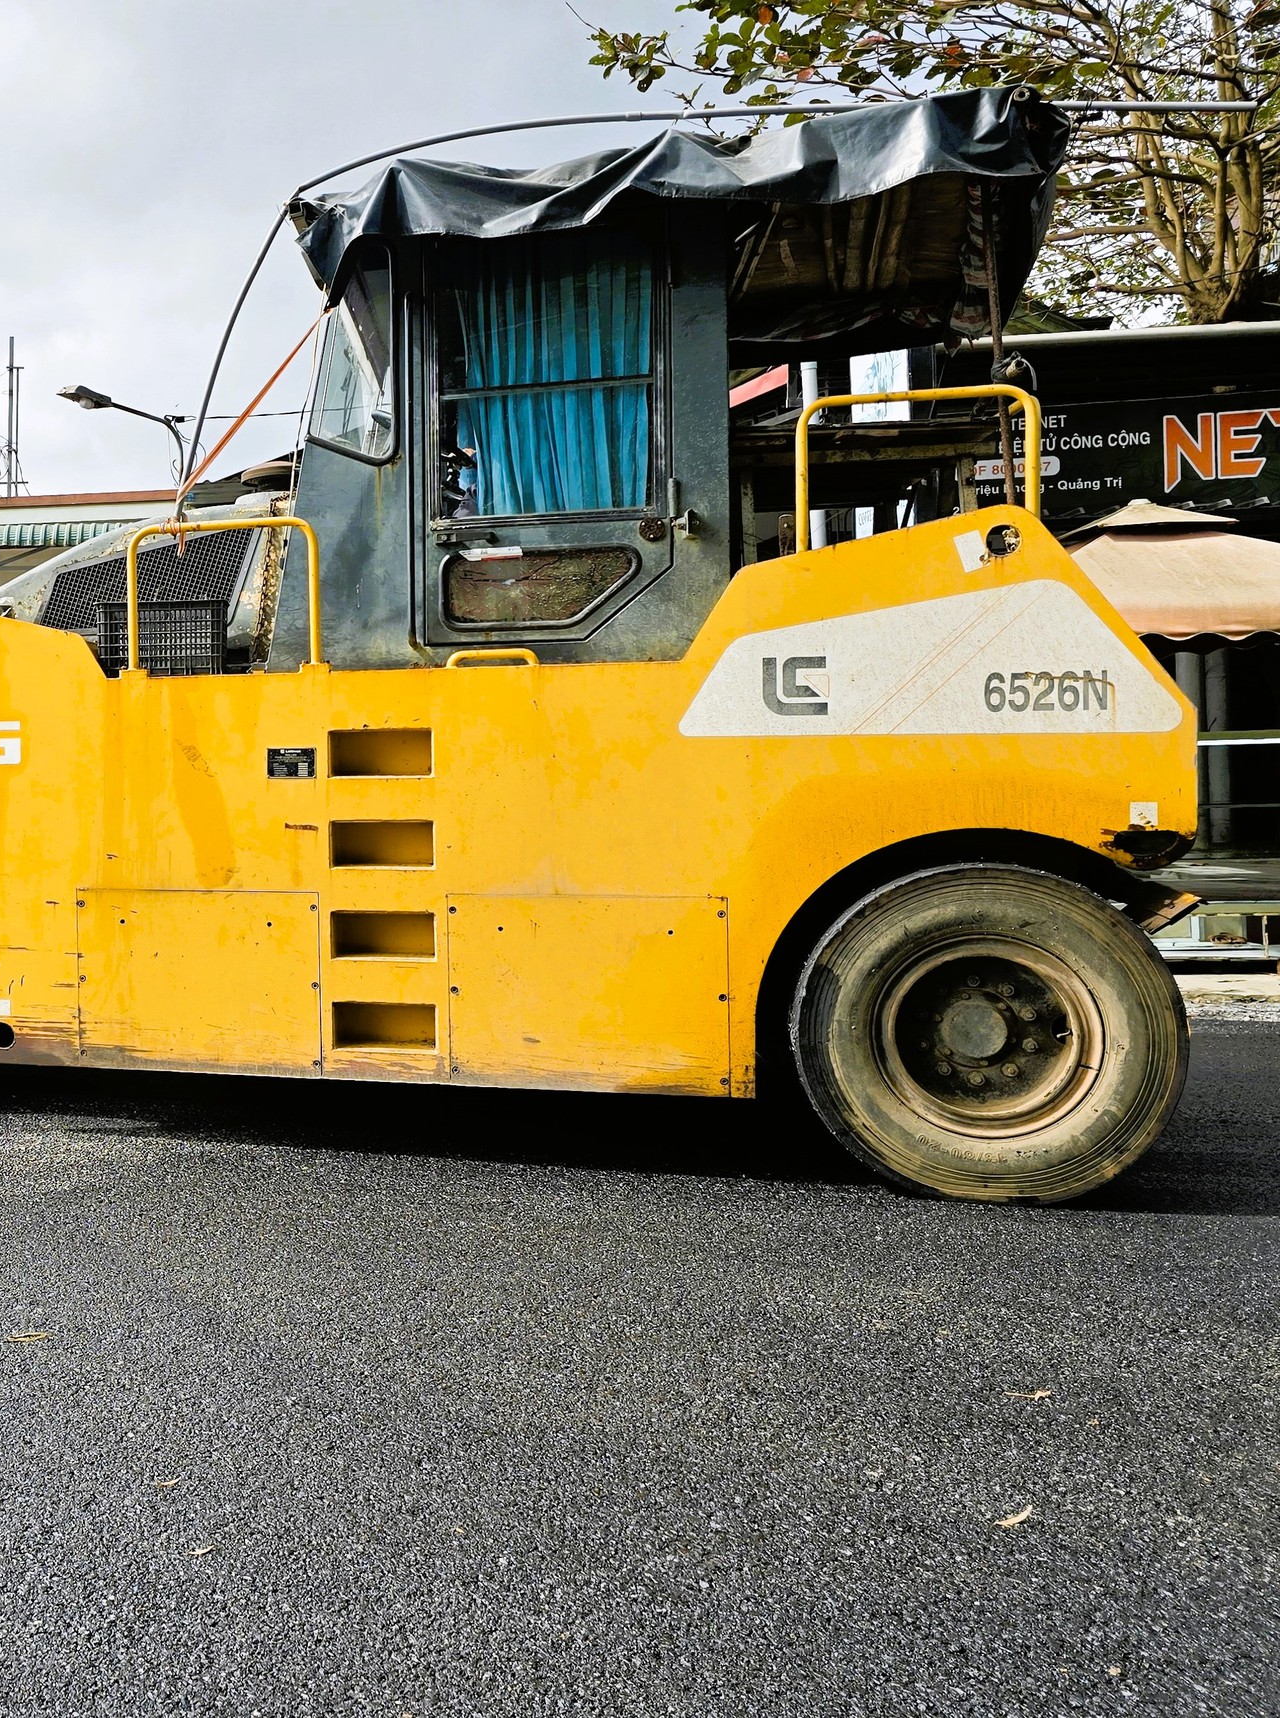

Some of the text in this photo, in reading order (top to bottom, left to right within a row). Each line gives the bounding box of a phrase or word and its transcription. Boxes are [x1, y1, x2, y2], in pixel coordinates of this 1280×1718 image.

[1060, 433, 1103, 450] CÔNG
[1107, 429, 1151, 448] CỘNG
[975, 484, 999, 497] riệu
[1057, 478, 1101, 492] Quảng
[1104, 477, 1122, 489] Trị
[984, 669, 1108, 713] 6526N
